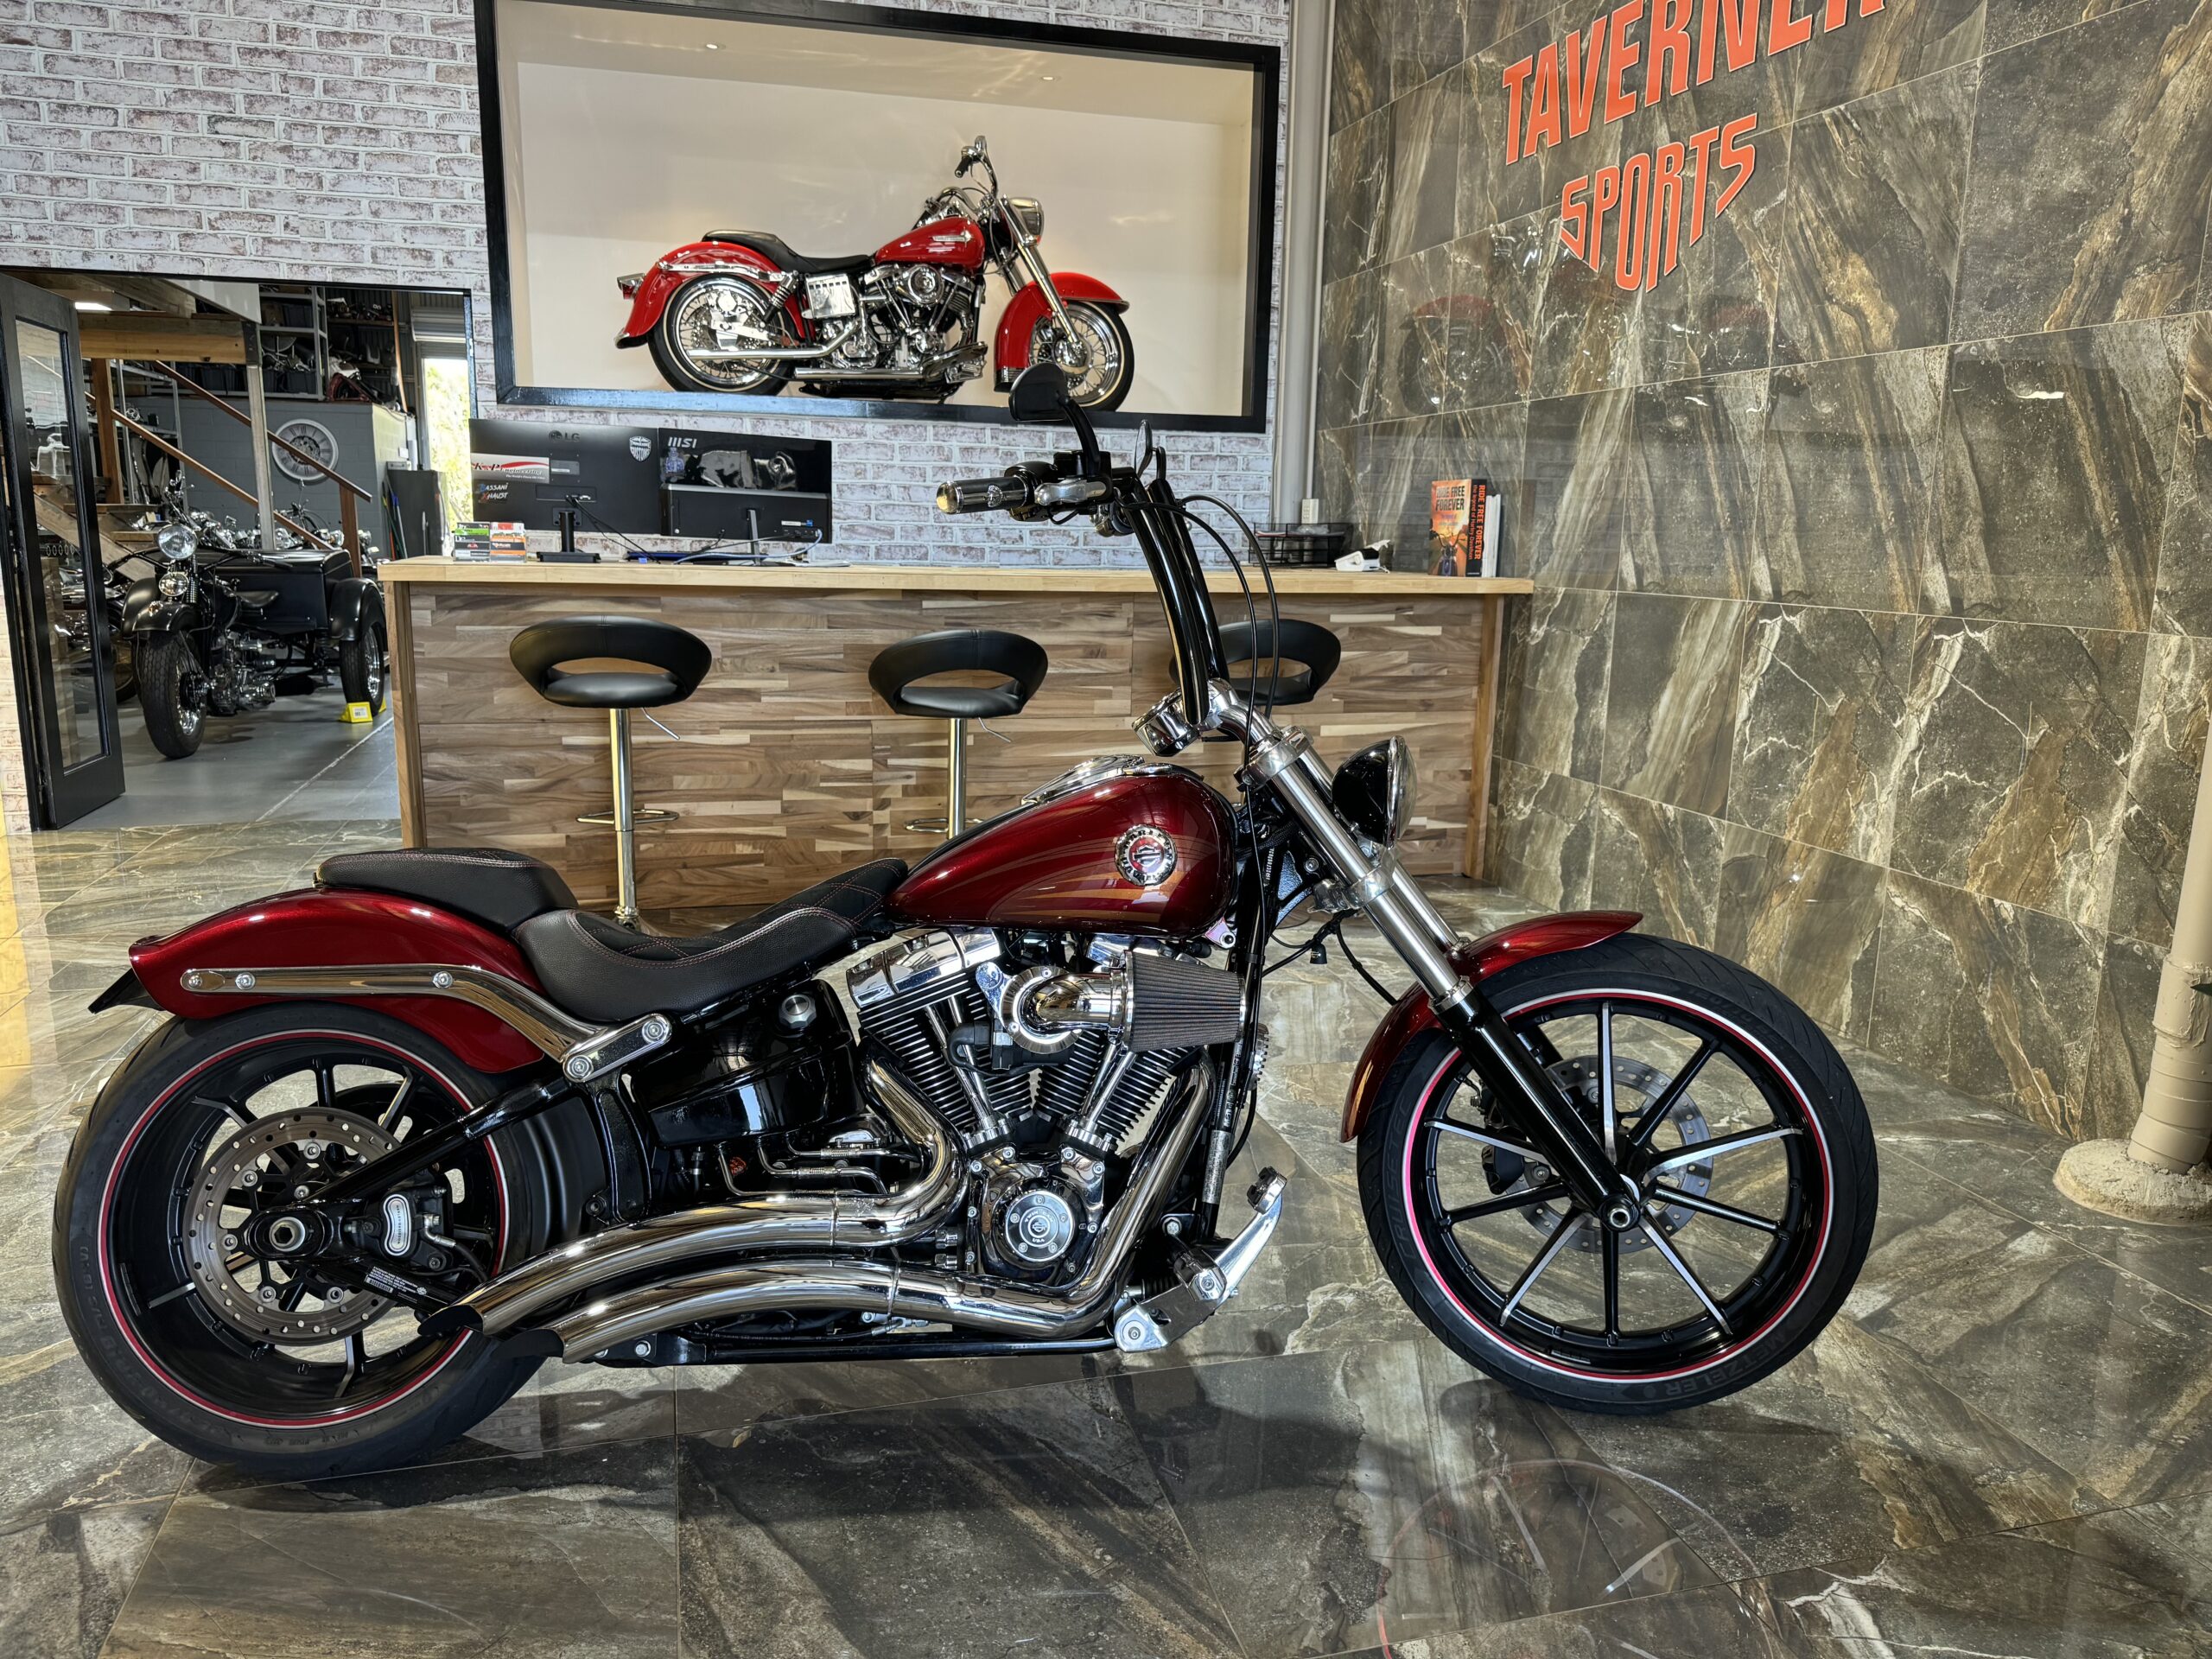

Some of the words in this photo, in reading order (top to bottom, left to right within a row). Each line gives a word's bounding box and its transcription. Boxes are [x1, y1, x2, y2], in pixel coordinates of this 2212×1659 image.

[1503, 0, 1885, 165] TAVERN
[1560, 113, 1758, 292] SPORTS
[1436, 499, 1465, 512] FOREVER
[1451, 486, 1465, 498] FREE
[1478, 485, 1486, 503] RIDE
[1474, 525, 1484, 560] FOREVER
[1386, 1096, 1417, 1260] CRUISETEC
[1665, 1330, 1789, 1396] METZELER
